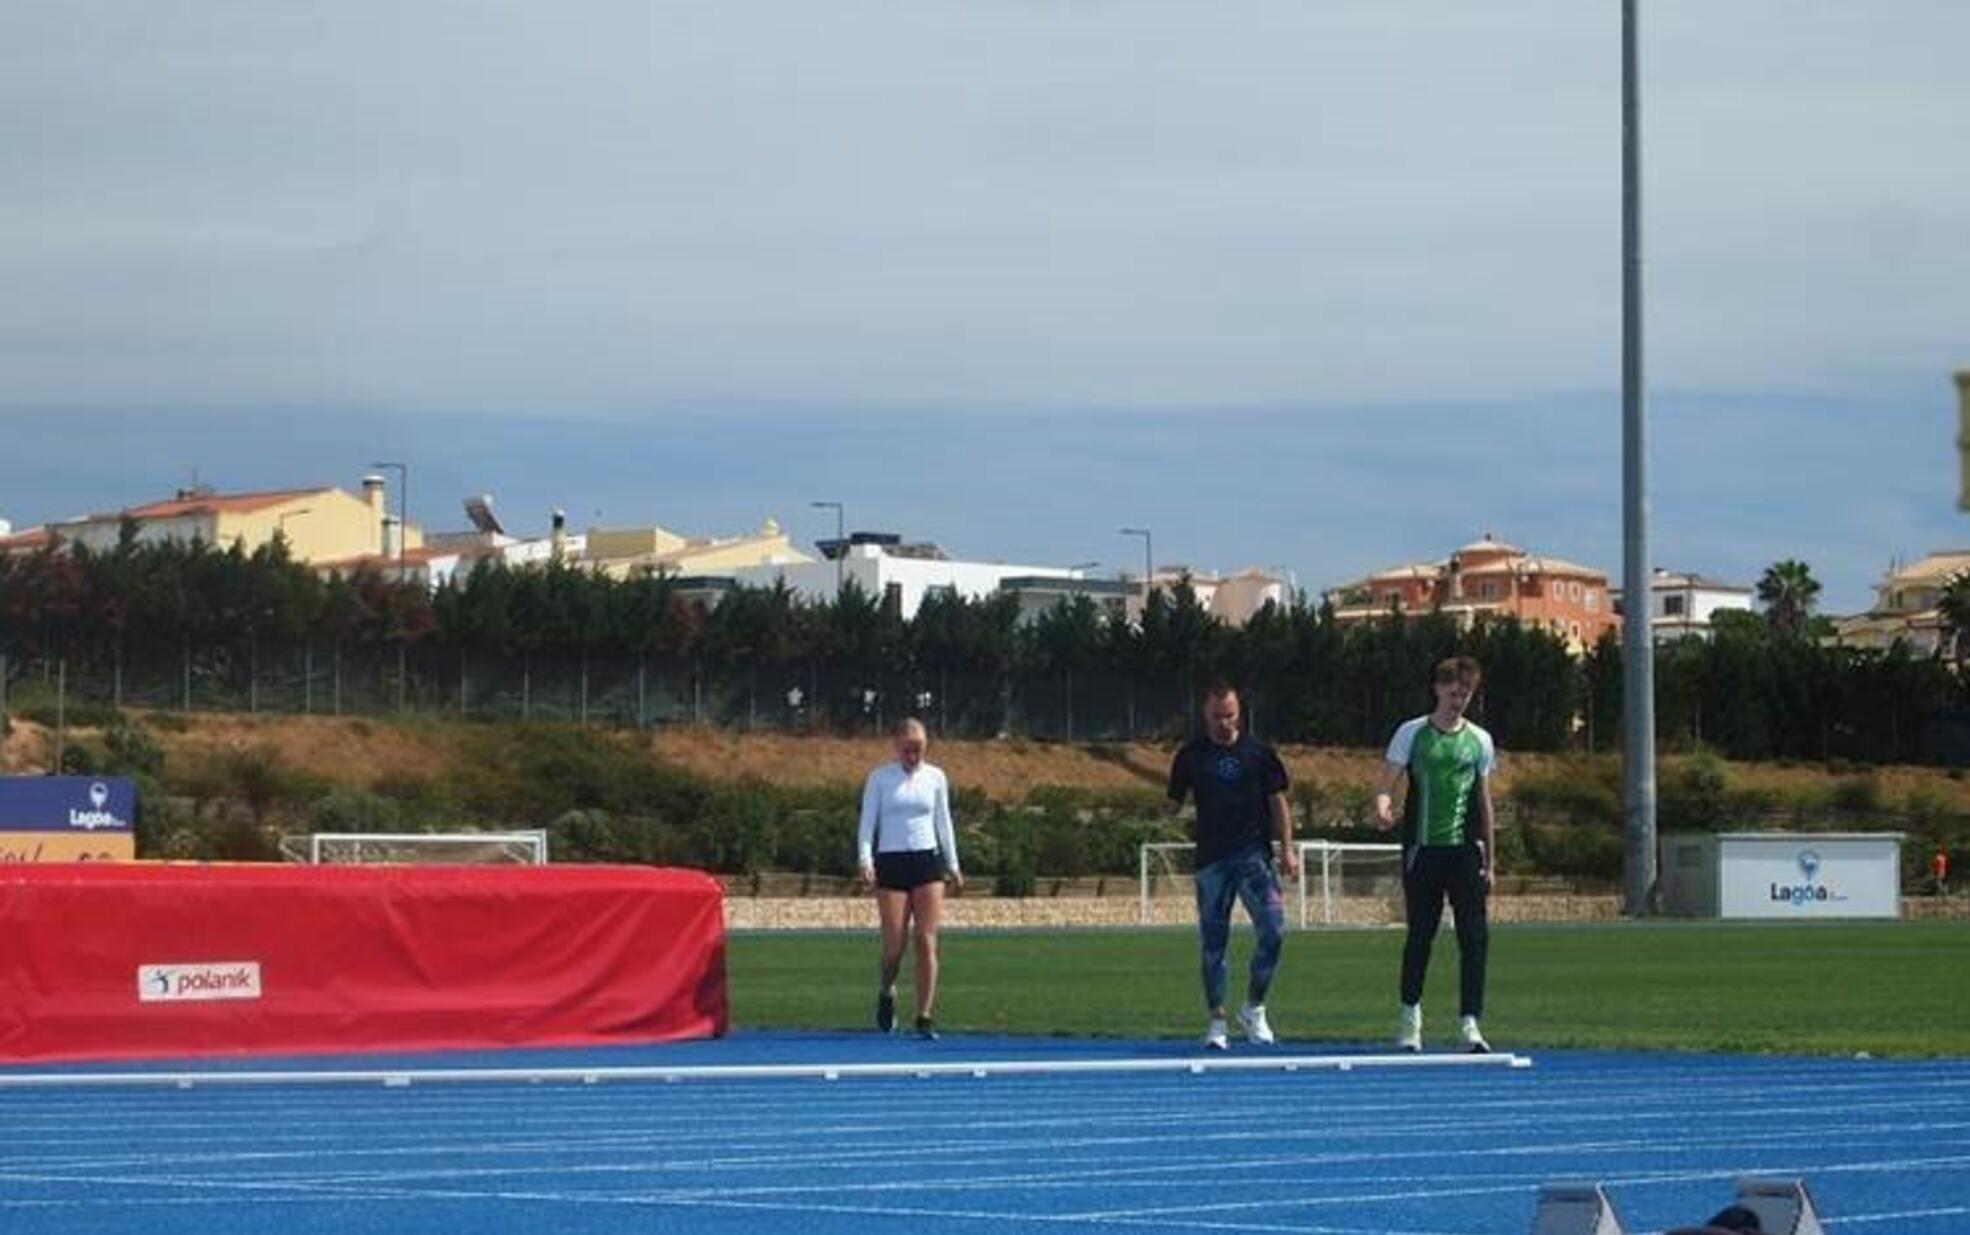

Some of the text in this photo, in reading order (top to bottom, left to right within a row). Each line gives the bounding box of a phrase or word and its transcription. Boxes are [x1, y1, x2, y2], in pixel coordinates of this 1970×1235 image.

[69, 808, 112, 829] Lagoa
[1771, 883, 1828, 905] Lagoa
[178, 968, 250, 994] polanik
